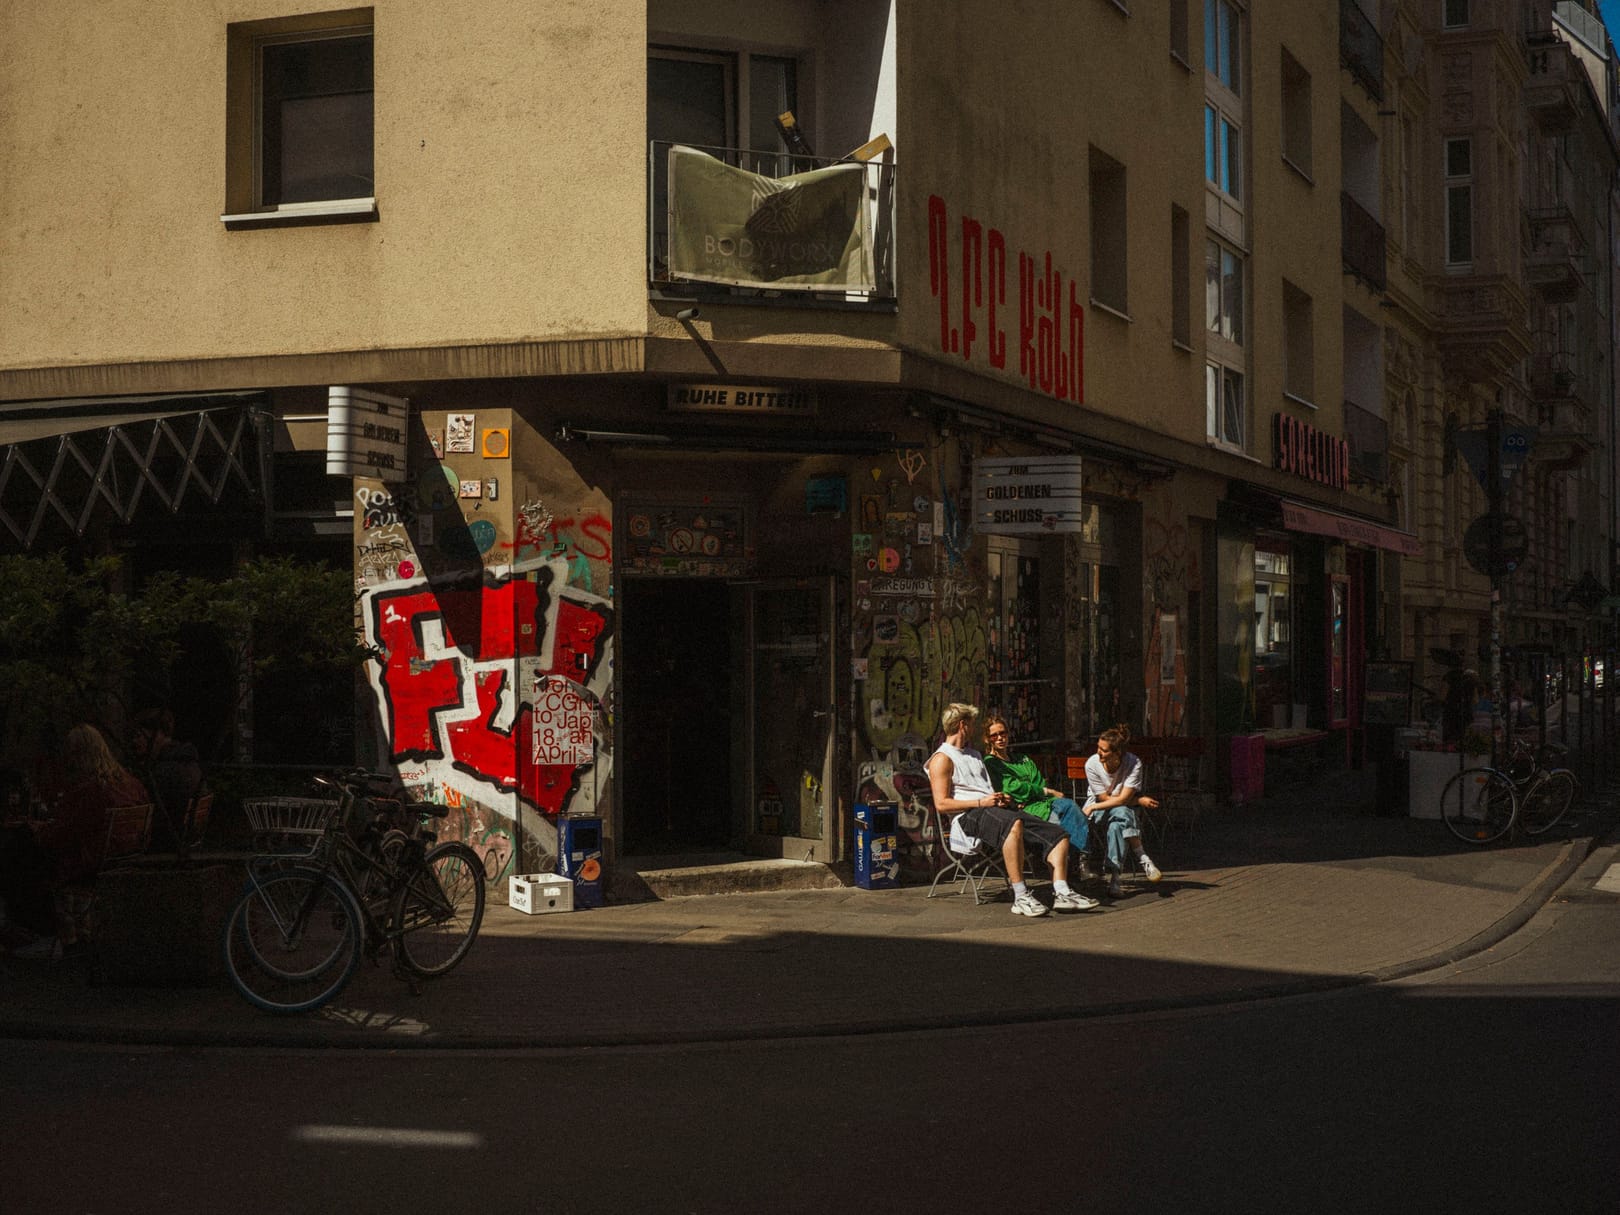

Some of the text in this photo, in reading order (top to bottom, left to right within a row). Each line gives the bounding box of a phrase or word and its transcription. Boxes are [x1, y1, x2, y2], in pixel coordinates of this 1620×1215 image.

[678, 389, 728, 406] RUHE
[1279, 411, 1350, 491] SORELLINA
[986, 484, 1052, 500] GOLDENEN
[993, 508, 1043, 524] SCHUSS
[546, 693, 593, 712] CGN
[534, 707, 553, 724] to
[557, 711, 592, 733] Jap
[534, 728, 560, 746] 18.
[534, 745, 577, 764] April
